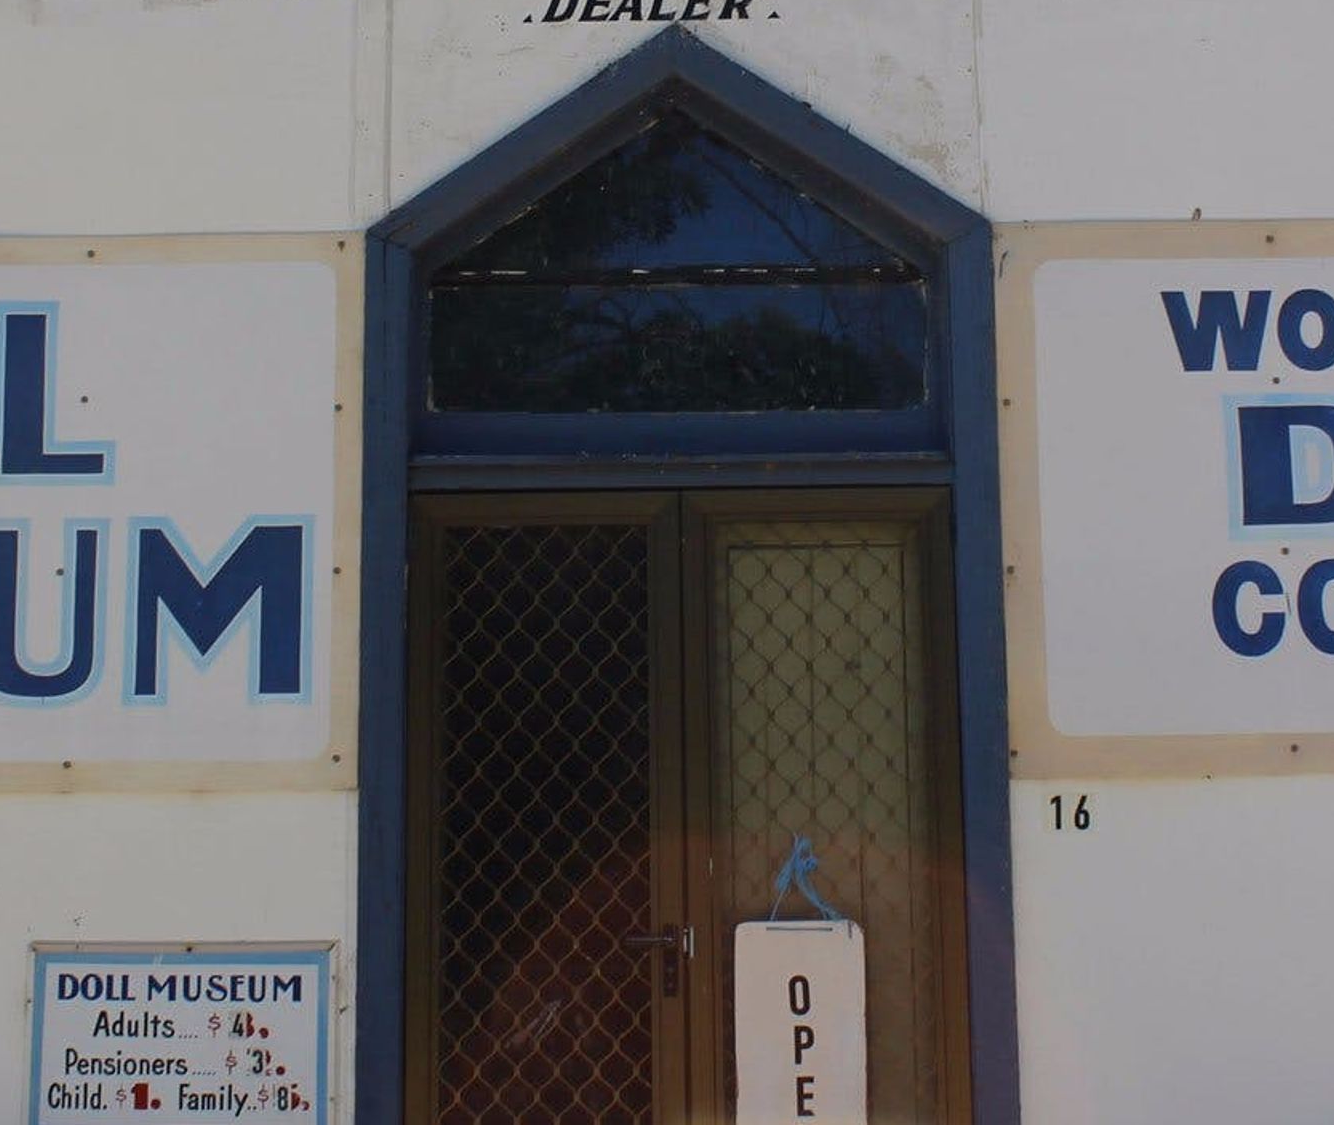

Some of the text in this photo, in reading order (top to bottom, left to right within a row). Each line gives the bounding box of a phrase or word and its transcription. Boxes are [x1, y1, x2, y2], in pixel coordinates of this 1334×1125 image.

[1050, 795, 1090, 830] 16
[57, 973, 302, 1003] DOLL MUSEUM
[48, 1082, 107, 1110] Child.
